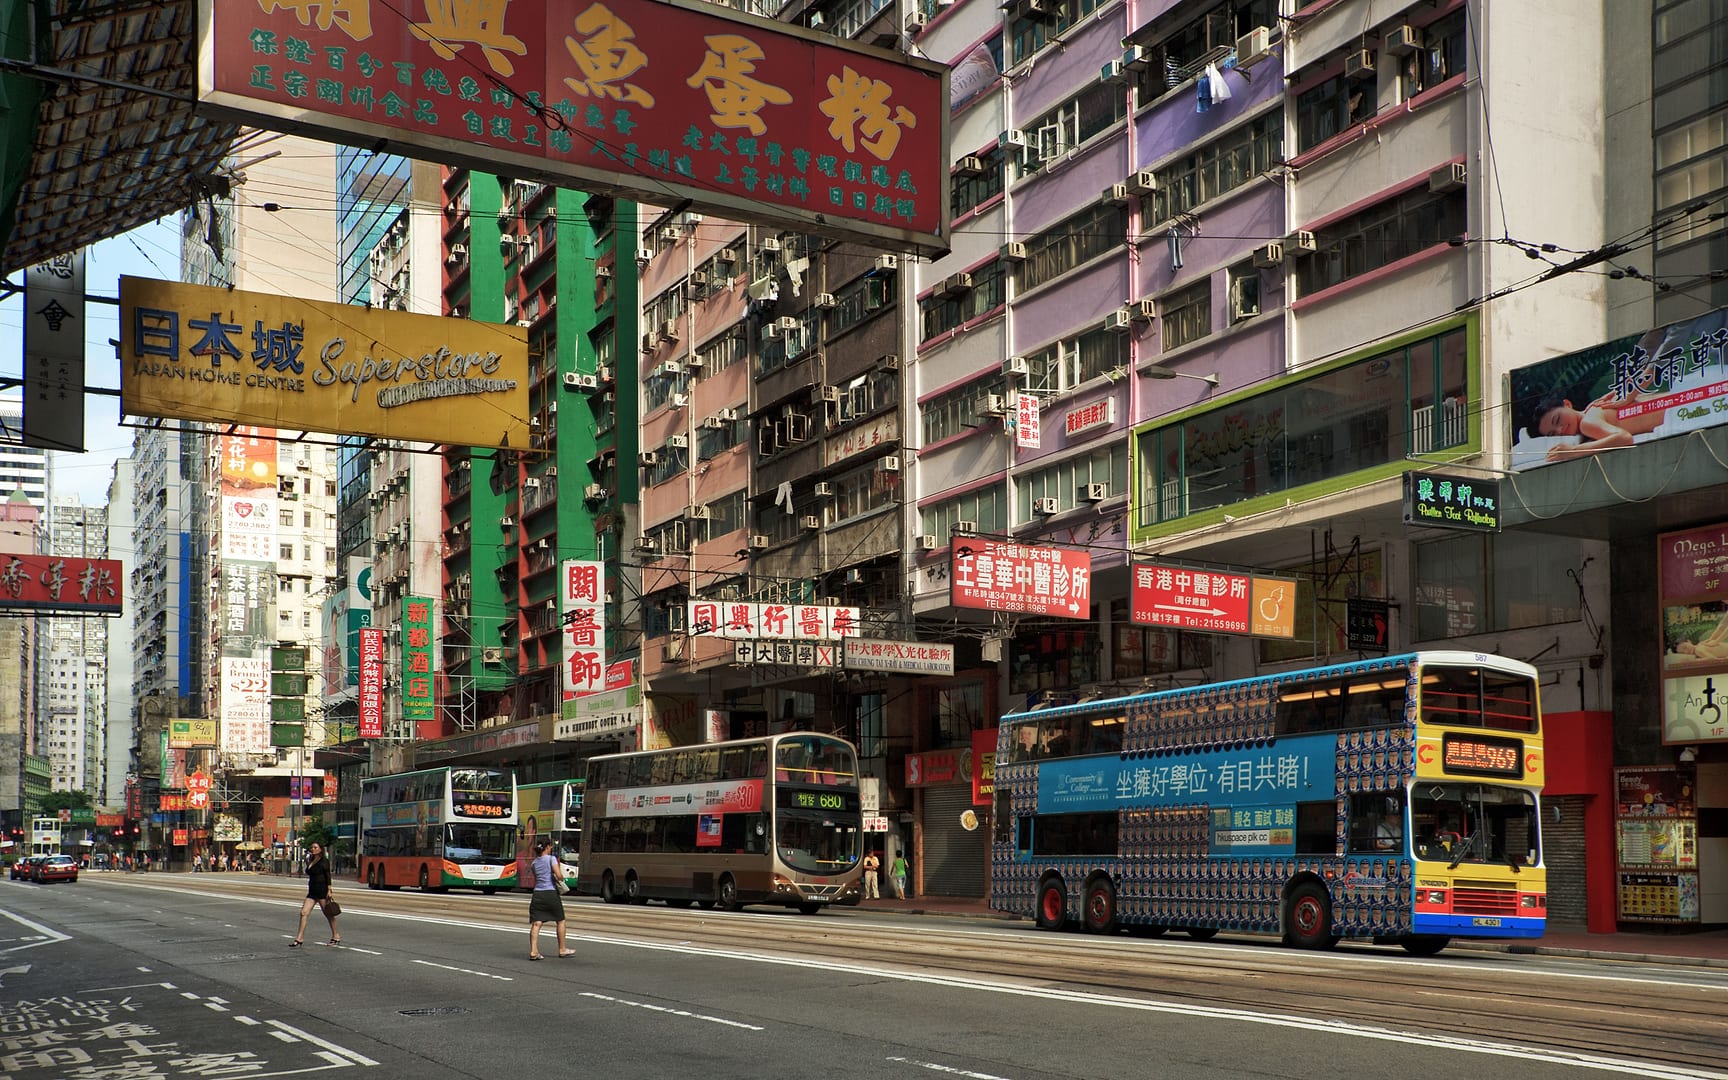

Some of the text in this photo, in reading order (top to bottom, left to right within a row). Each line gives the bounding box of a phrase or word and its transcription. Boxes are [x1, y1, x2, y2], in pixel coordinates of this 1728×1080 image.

[135, 307, 305, 374] 日本城
[132, 359, 305, 393] JAPAN HOME CENTRE
[311, 335, 503, 402] Superstore
[1673, 539, 1716, 556] Mega
[956, 553, 1089, 600] 王雪華中醫診所
[1136, 567, 1247, 600] 香港中醫診所
[1704, 579, 1720, 590] 3/F
[984, 599, 1005, 610] TEL:
[565, 564, 601, 690] 關醫師
[407, 602, 430, 698] 新都酒店
[1711, 727, 1725, 737] 1/F
[1486, 747, 1517, 769] 969
[485, 806, 502, 817] 948
[820, 793, 842, 809] 680
